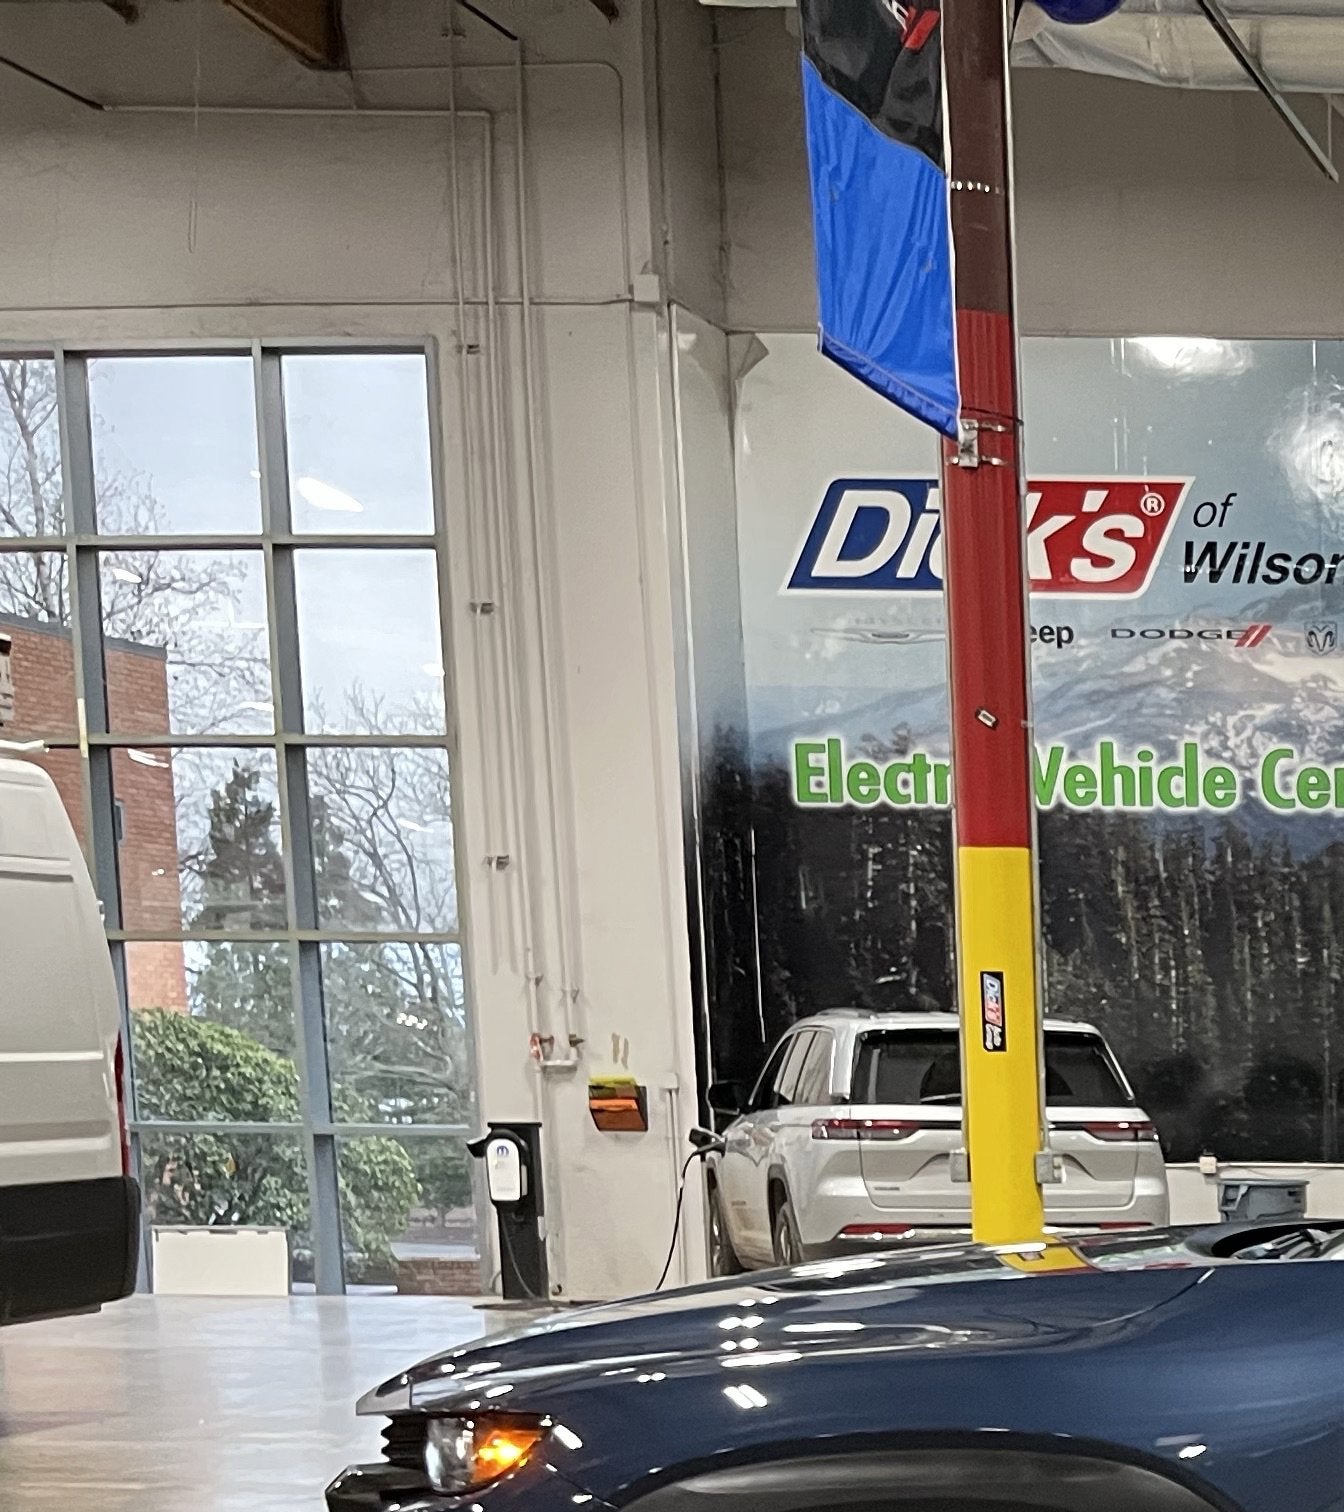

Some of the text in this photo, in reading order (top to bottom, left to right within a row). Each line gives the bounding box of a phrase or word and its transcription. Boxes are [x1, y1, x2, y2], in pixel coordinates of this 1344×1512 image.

[811, 489, 1144, 582] Dik's
[1193, 493, 1237, 527] of
[1111, 628, 1246, 640] DODGE
[795, 738, 950, 804] Electr
[1034, 741, 1237, 808] Vehicle
